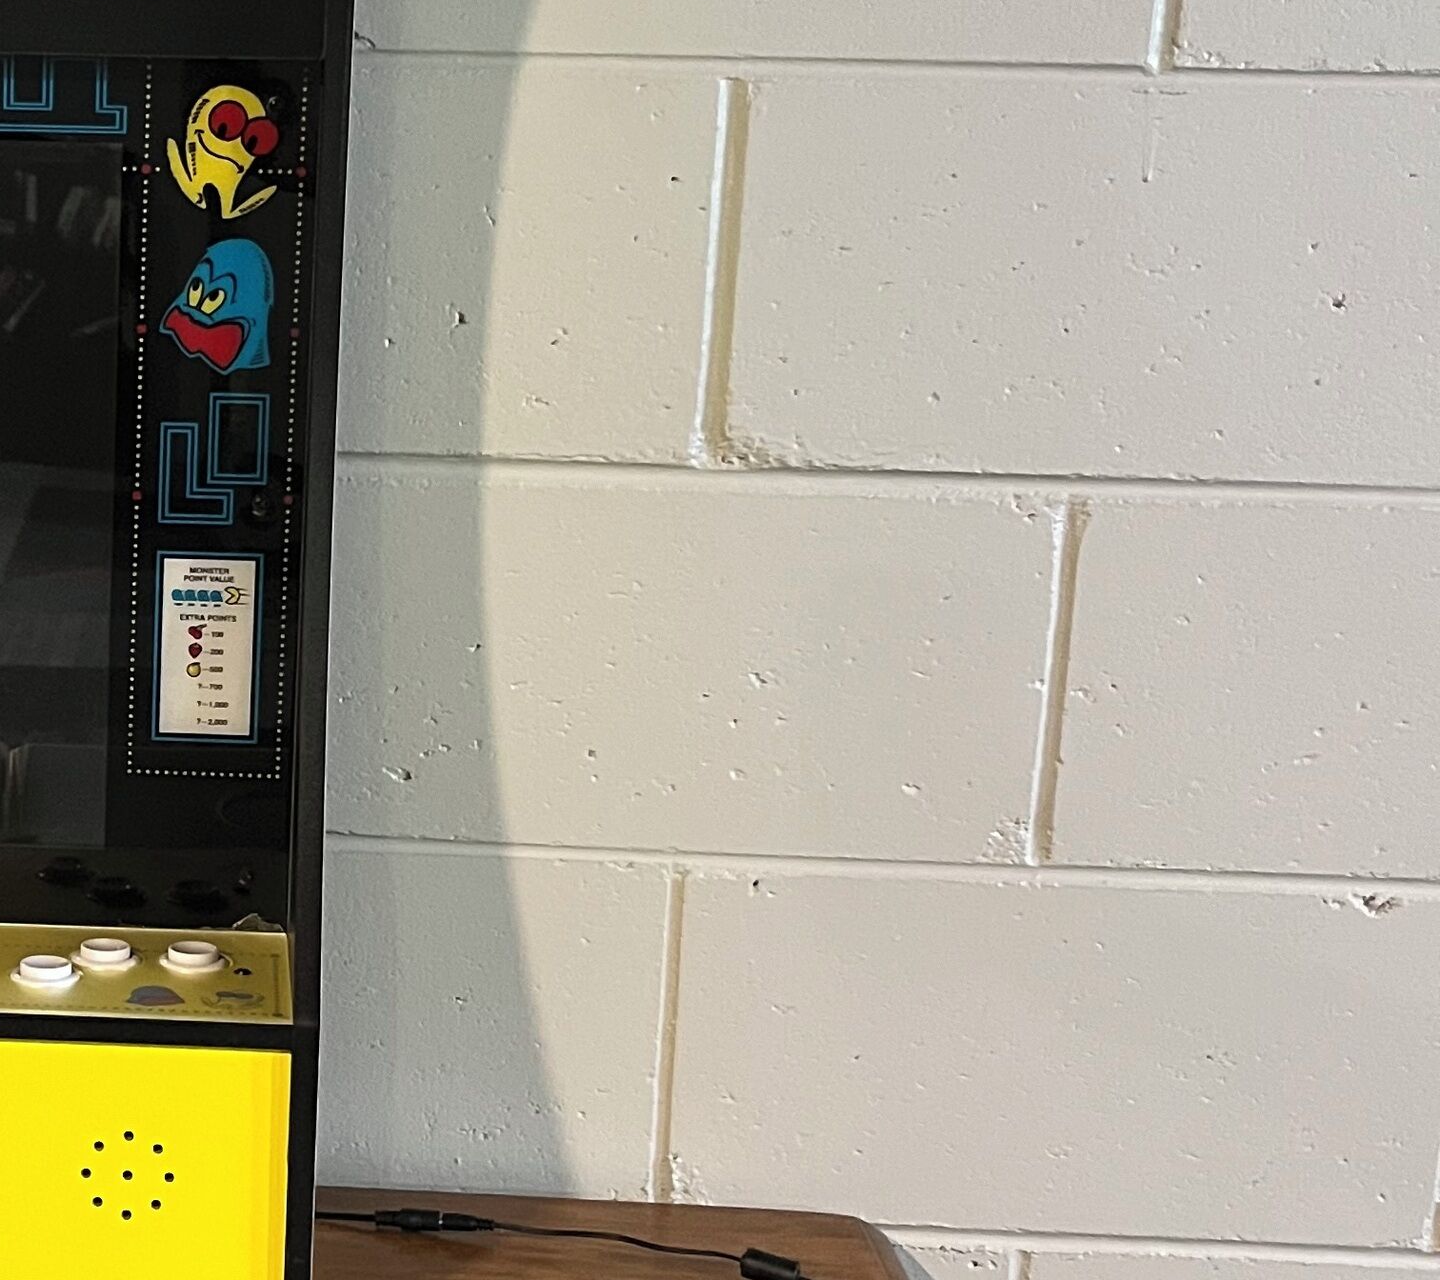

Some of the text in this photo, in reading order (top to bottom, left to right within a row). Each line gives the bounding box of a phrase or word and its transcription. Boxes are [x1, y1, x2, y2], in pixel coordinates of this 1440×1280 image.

[189, 566, 230, 574] MONSTER
[183, 574, 235, 583] POINT VALUE
[179, 613, 237, 622] EXTRA POINTS
